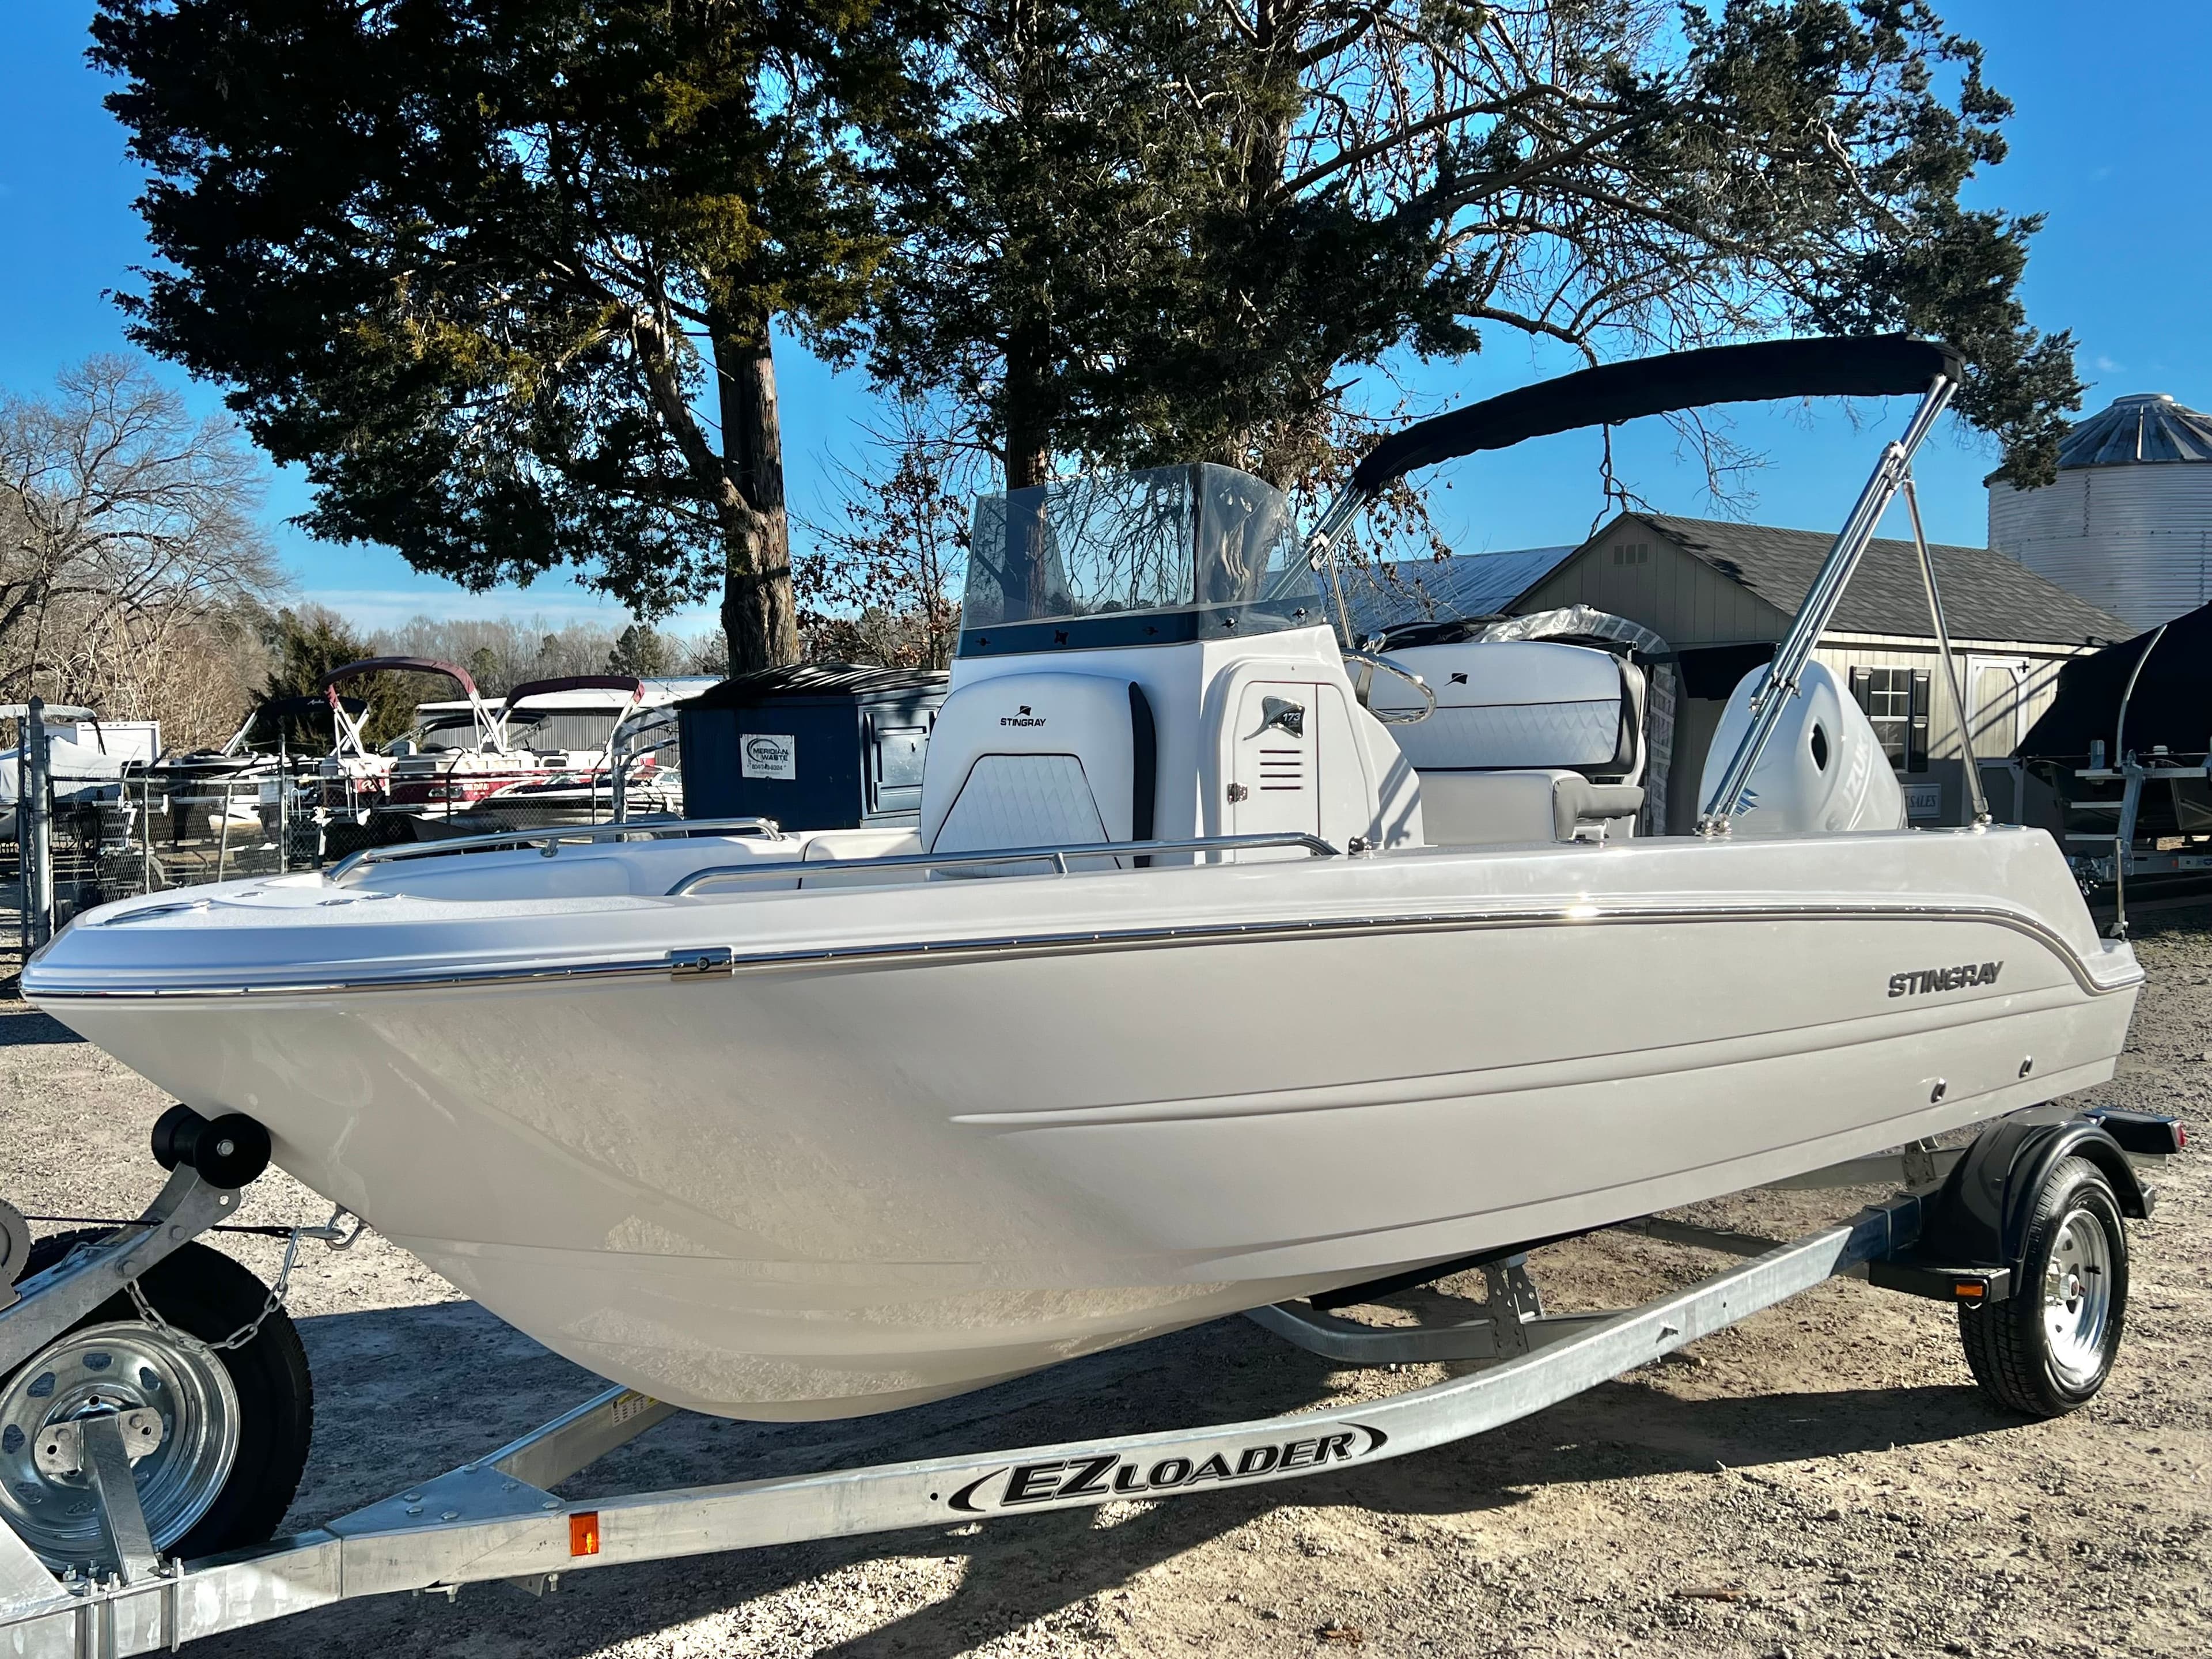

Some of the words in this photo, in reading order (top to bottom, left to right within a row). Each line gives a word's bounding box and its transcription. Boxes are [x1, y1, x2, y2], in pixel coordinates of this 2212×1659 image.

[1000, 718, 1047, 726] STINGRAY
[1283, 713, 1301, 721] 173
[1910, 795, 1937, 808] SALES
[1888, 960, 2005, 998] STINGRAY
